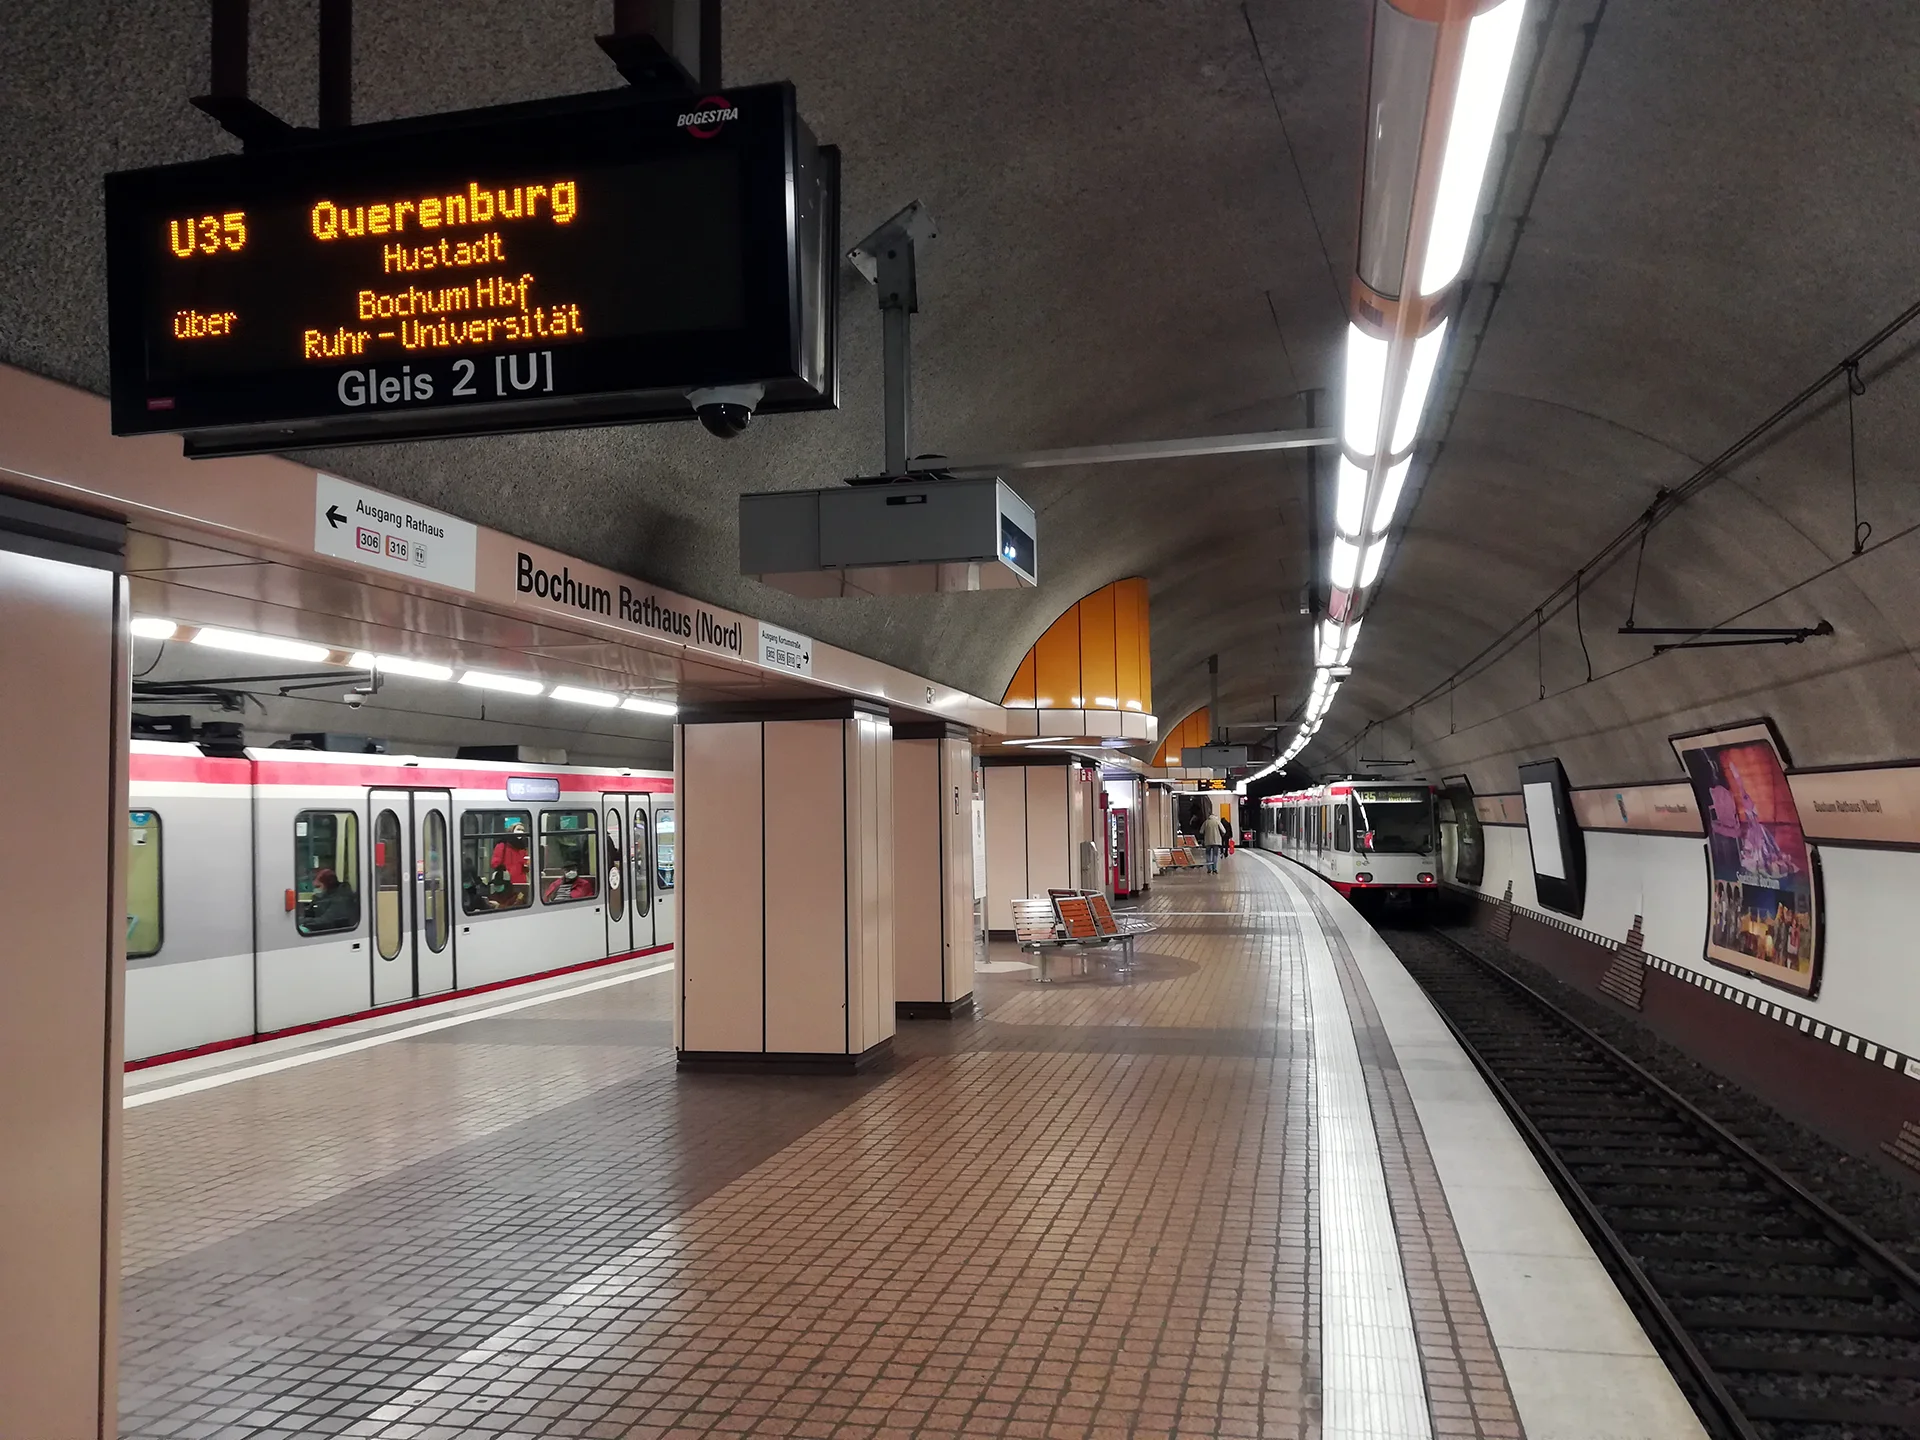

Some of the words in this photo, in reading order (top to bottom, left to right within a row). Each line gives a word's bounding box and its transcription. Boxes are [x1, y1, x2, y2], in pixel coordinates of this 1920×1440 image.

[676, 107, 738, 127] BOGESTRA
[312, 181, 576, 240] Querenburg
[170, 212, 246, 257] U35
[384, 232, 505, 273] Hustadt
[358, 286, 470, 320] Bochum
[476, 273, 534, 313] Hbf
[174, 310, 237, 338] über
[337, 365, 434, 406] Gleis
[452, 359, 477, 396] 2
[495, 351, 553, 396] [U]
[356, 499, 402, 529] Ausgang
[406, 514, 444, 539] Rathaus
[361, 533, 379, 549] 306
[390, 541, 407, 556] 316
[517, 551, 611, 616] Bochum
[619, 584, 692, 639] Rathaus
[695, 608, 743, 656] (Nord)
